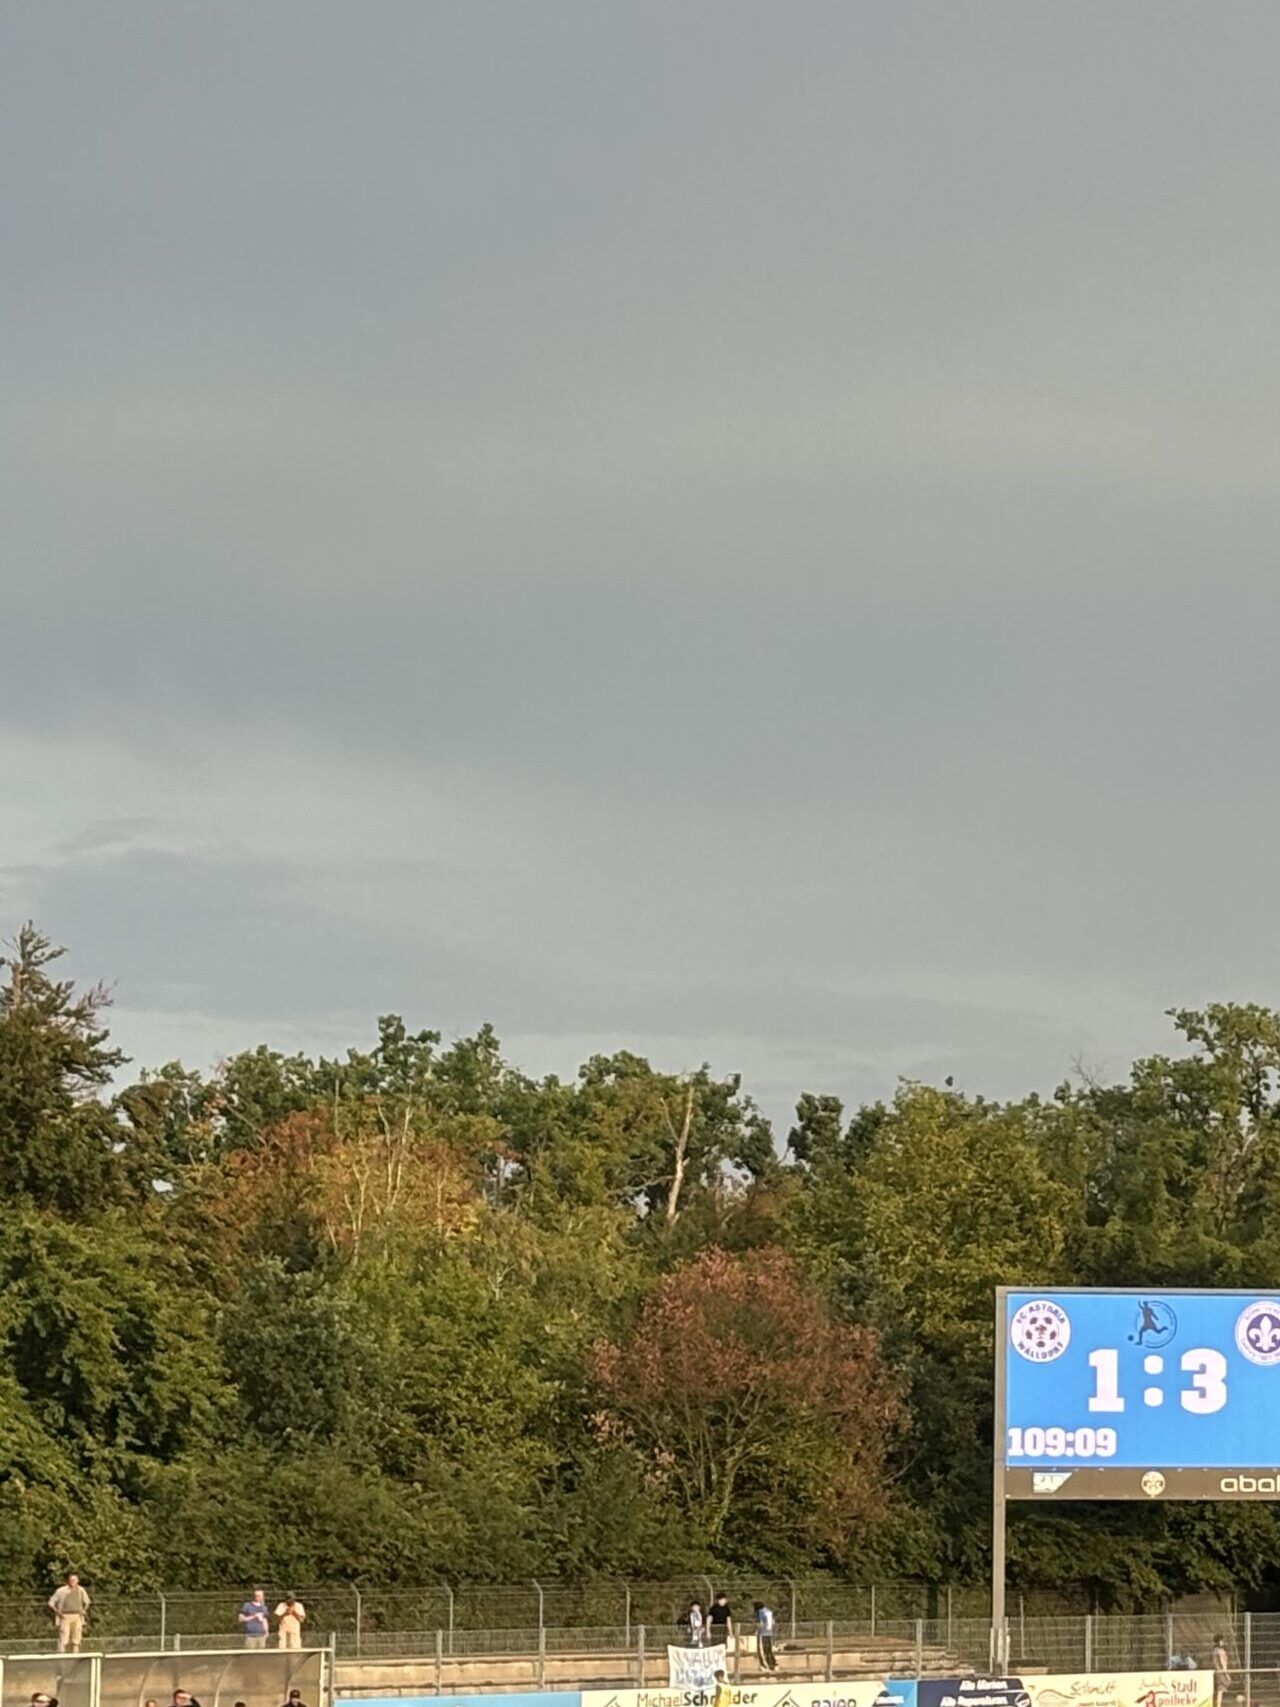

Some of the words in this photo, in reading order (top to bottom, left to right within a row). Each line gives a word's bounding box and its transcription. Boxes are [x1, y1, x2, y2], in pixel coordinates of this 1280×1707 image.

[1088, 1349, 1125, 1412] 1
[1181, 1348, 1227, 1414] 3
[1008, 1427, 1117, 1457] 109:09
